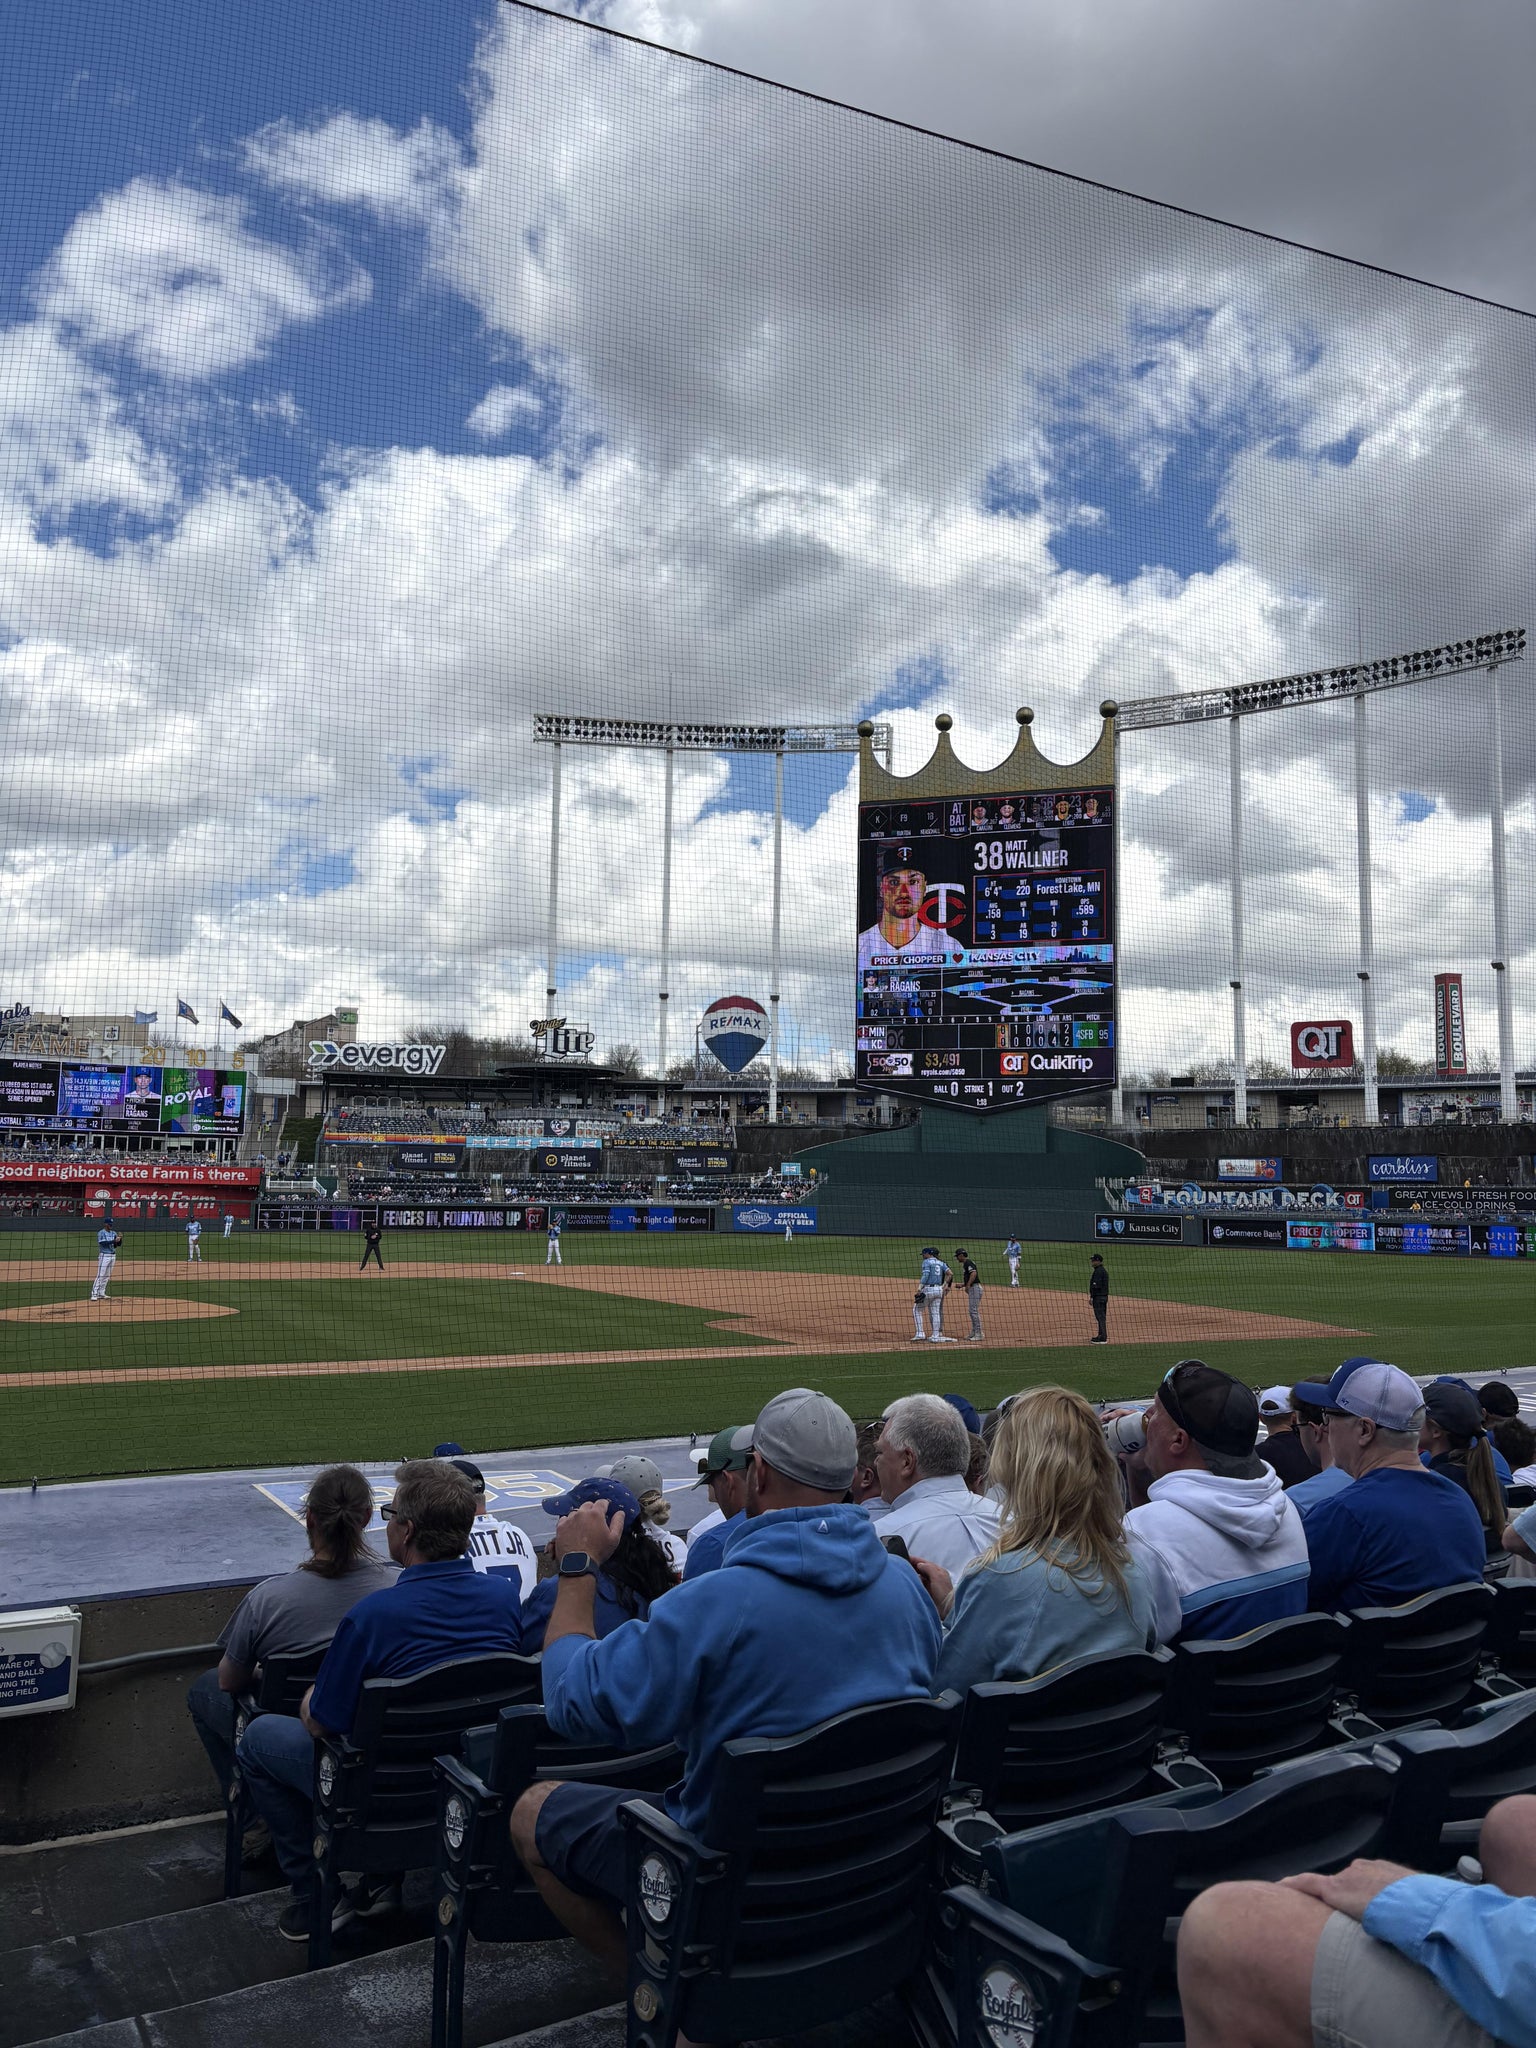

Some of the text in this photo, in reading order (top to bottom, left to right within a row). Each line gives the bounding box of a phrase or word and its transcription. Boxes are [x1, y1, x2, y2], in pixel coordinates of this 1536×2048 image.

[952, 802, 963, 814] AT
[1070, 796, 1082, 808] 23
[900, 813, 908, 822] F9
[949, 814, 966, 826] BAT
[1005, 840, 1028, 851] MATT
[974, 841, 1003, 870] 38
[1005, 849, 1069, 869] WALLNER
[1016, 885, 1030, 896] 220
[1036, 881, 1101, 895] Forest Lake, MN
[985, 909, 1001, 919] .158
[1076, 904, 1095, 916] .589
[990, 930, 996, 940] 3
[1019, 928, 1028, 939] 19
[1051, 928, 1057, 937] 0
[1082, 926, 1088, 936] 0
[874, 955, 944, 966] PRICE CHOPPER
[970, 951, 1041, 961] KANSAS CITY
[890, 981, 921, 992] RAGANS
[530, 1018, 567, 1037] Miller
[710, 1015, 761, 1030] RE/MAX
[1437, 990, 1446, 1062] BOULEVARD
[1451, 990, 1465, 1062] BOULEVARD
[869, 1024, 1109, 1039] MIN 0 0 4 2 4SFB 95
[13, 1032, 90, 1058] FAME
[542, 1028, 595, 1060] Lite
[871, 1036, 1070, 1049] KC 0 0 0 4 2
[1297, 1026, 1343, 1060] QT
[140, 1045, 166, 1066] 20
[185, 1048, 207, 1067] 10
[231, 1051, 245, 1069] 5
[342, 1045, 444, 1073] evergy
[894, 1057, 909, 1066] 50
[925, 1052, 960, 1068] $3,491
[1003, 1054, 1094, 1073] QT QuikTrip
[921, 1068, 966, 1077] royals.com/5050
[933, 1081, 1024, 1096] BALL 0 STRIKE 1 OUT 2
[165, 1087, 211, 1106] ROYAL
[126, 1110, 148, 1118] RAGANS
[37, 1118, 45, 1126] 95
[65, 1119, 73, 1127] 20
[89, 1120, 98, 1128] -12
[402, 1152, 423, 1160] planet
[561, 1154, 586, 1162] planet
[1372, 1157, 1433, 1175] carbliss
[37, 1164, 105, 1180] neighbor,
[110, 1166, 147, 1179] State
[153, 1166, 189, 1179] Farm
[193, 1168, 204, 1180] is
[208, 1169, 248, 1181] there.
[1163, 1190, 1274, 1207] FOUNTAIN
[1282, 1191, 1341, 1207] DECK
[1347, 1194, 1361, 1206] QT
[1395, 1190, 1428, 1199] GREAT
[1433, 1191, 1464, 1200] VIEWS
[1472, 1191, 1507, 1200] FRESH
[1422, 1201, 1516, 1210] ICE-COLD DRINKS
[383, 1210, 521, 1228] FENCES IN, FOUNTAINS UP
[628, 1215, 707, 1226] The Right Call for Care
[1129, 1223, 1180, 1235] Kansas City
[1225, 1228, 1281, 1238] Commerce Bank
[1293, 1227, 1368, 1238] PRICE CHOPPER
[1377, 1227, 1453, 1238] SUNDAY 4-PACK
[1485, 1231, 1536, 1242] UNITE
[935, 1264, 941, 1276] 9
[506, 1531, 529, 1560] JR.
[24, 1659, 35, 1668] OF
[18, 1668, 45, 1677] BALLS
[16, 1688, 39, 1697] FIELD
